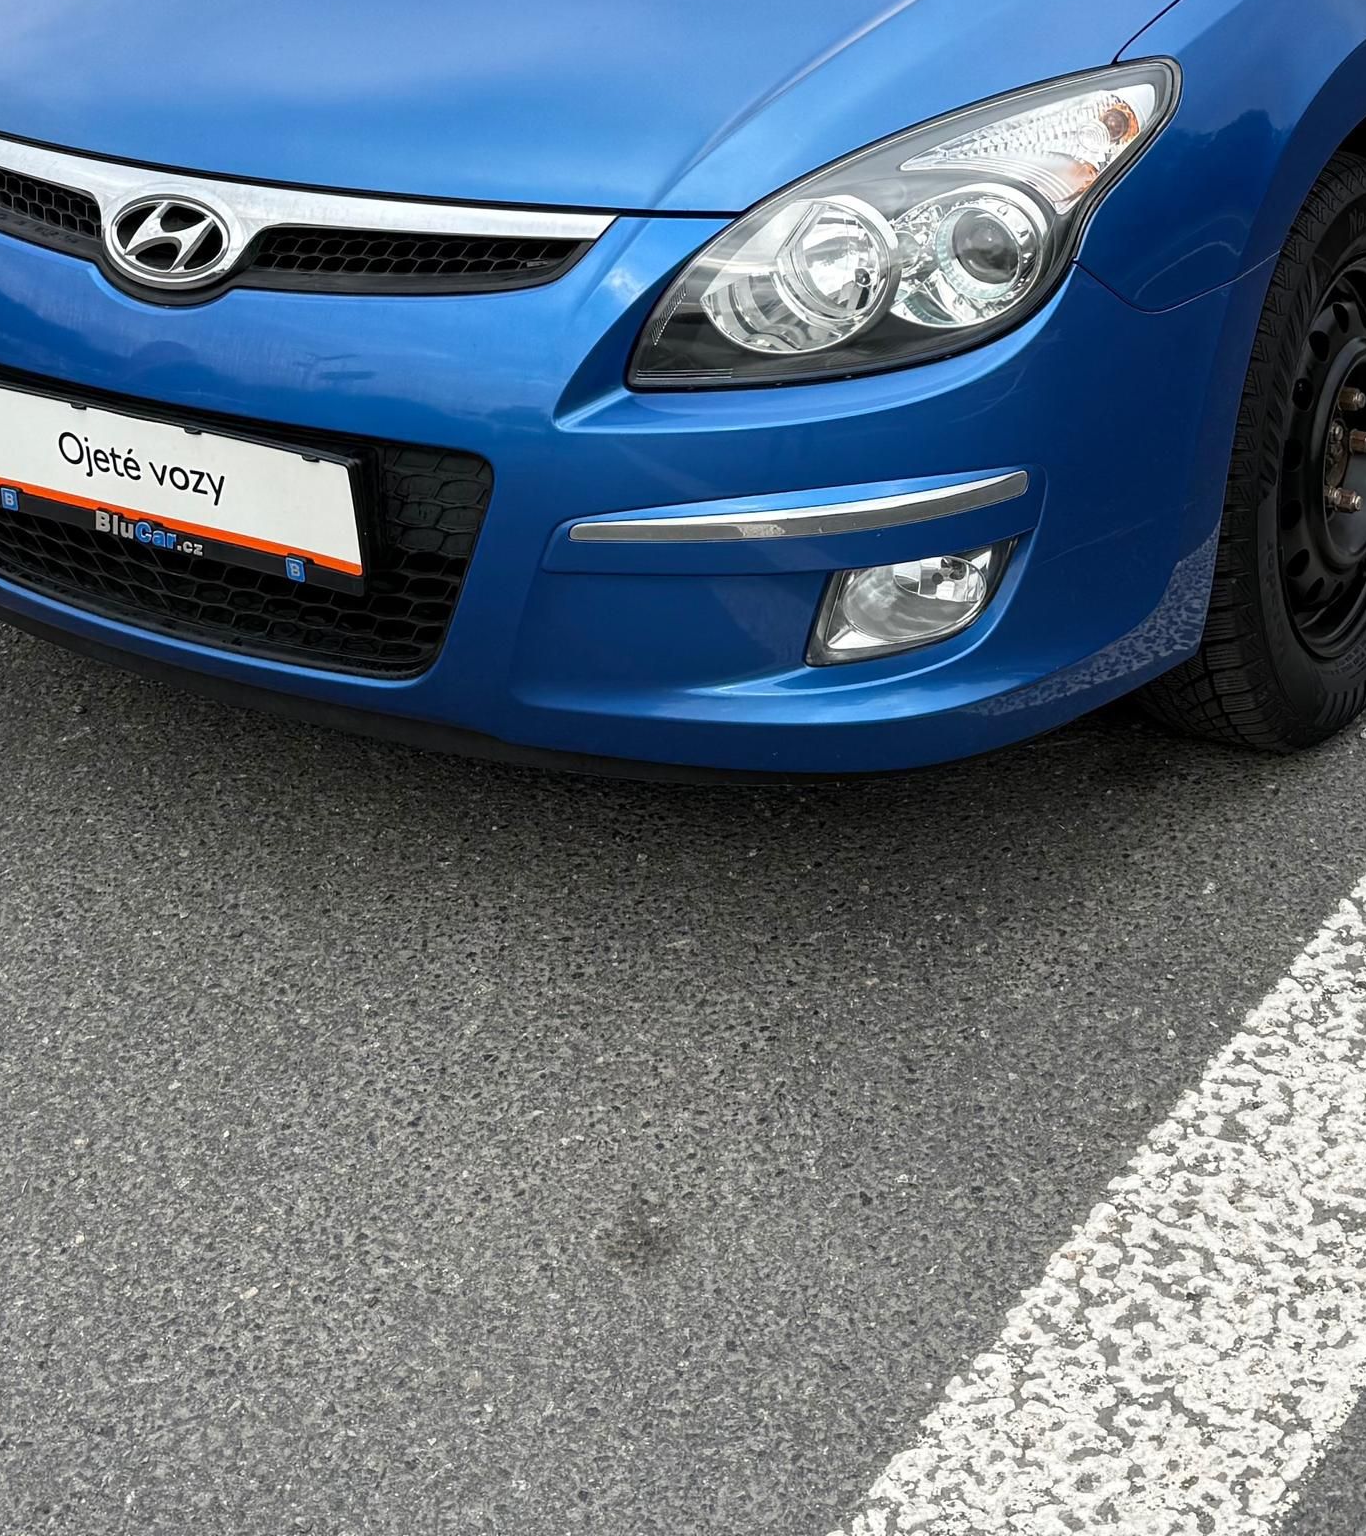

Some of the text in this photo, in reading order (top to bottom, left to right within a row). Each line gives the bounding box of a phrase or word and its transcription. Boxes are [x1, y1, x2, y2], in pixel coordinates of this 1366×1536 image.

[58, 431, 225, 506] Ojeté vozy
[95, 510, 203, 556] BluCar.cz
